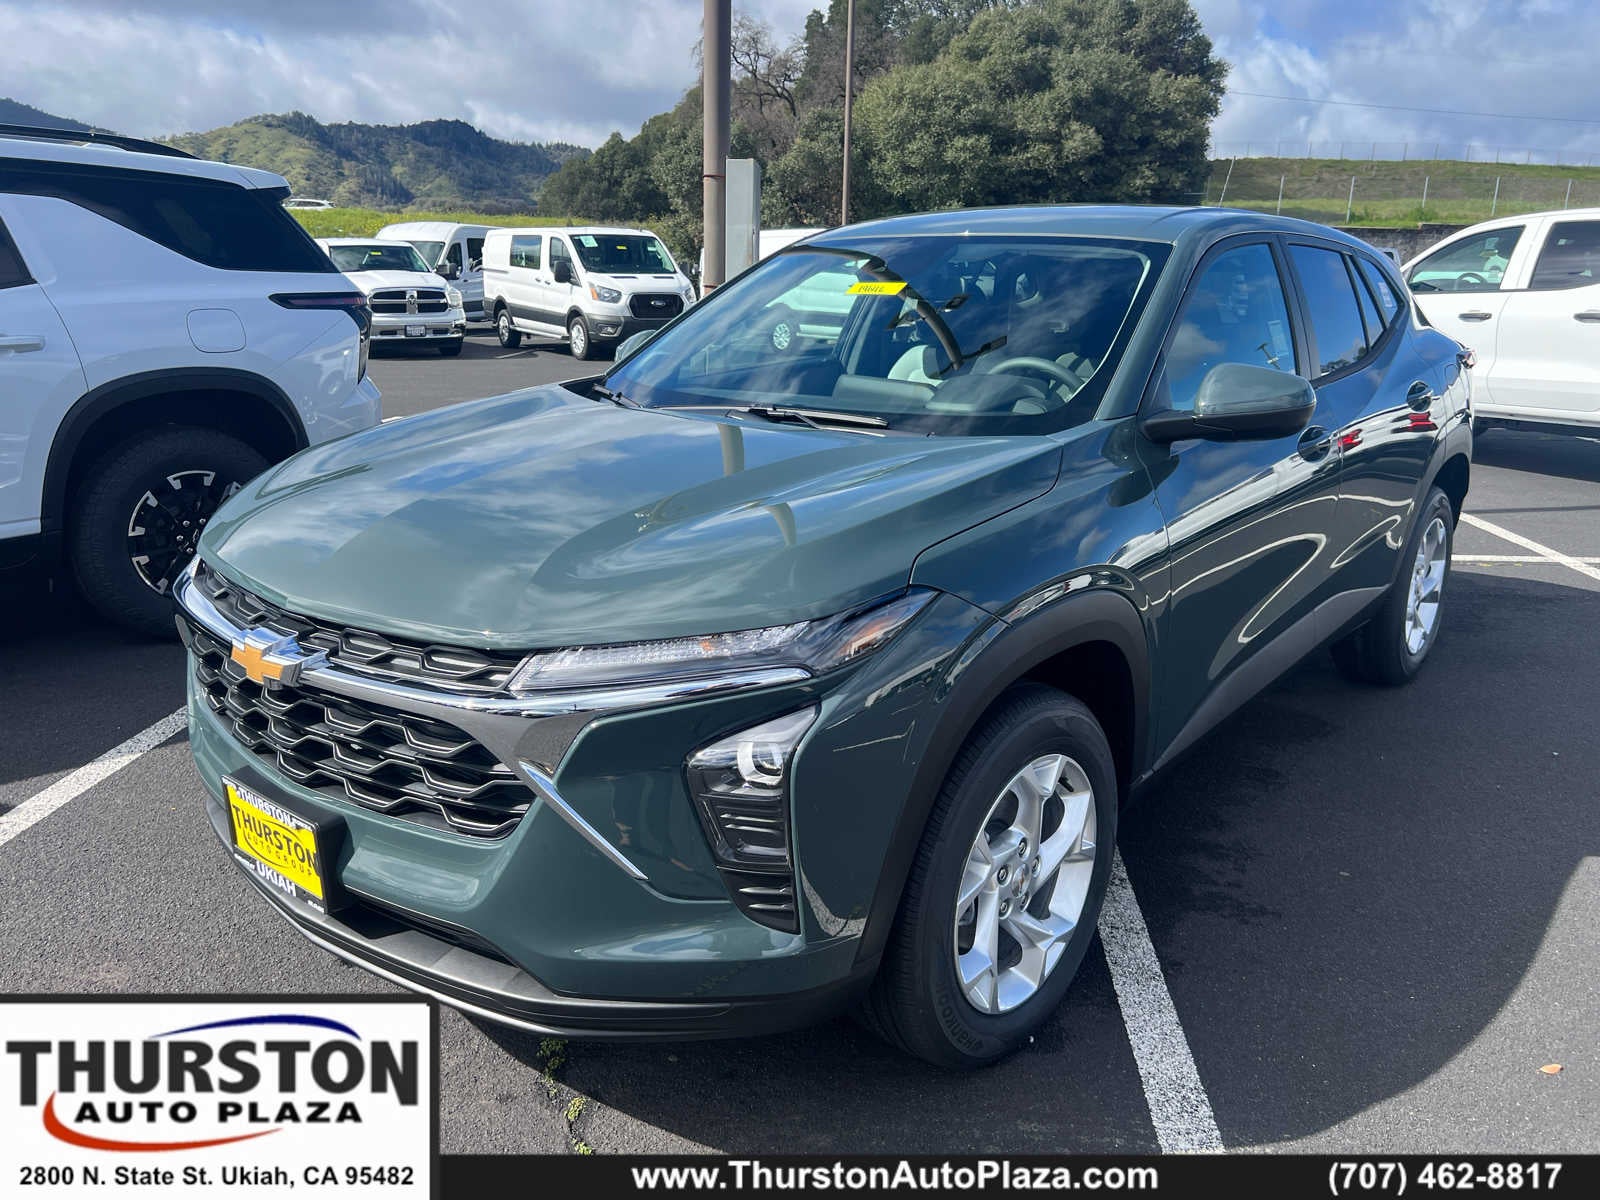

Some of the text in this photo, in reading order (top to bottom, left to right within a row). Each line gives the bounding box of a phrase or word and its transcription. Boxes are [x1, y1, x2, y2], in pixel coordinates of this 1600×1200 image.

[240, 788, 293, 827] THURSTON
[232, 804, 316, 868] THURSTON
[256, 860, 297, 897] UKIAH
